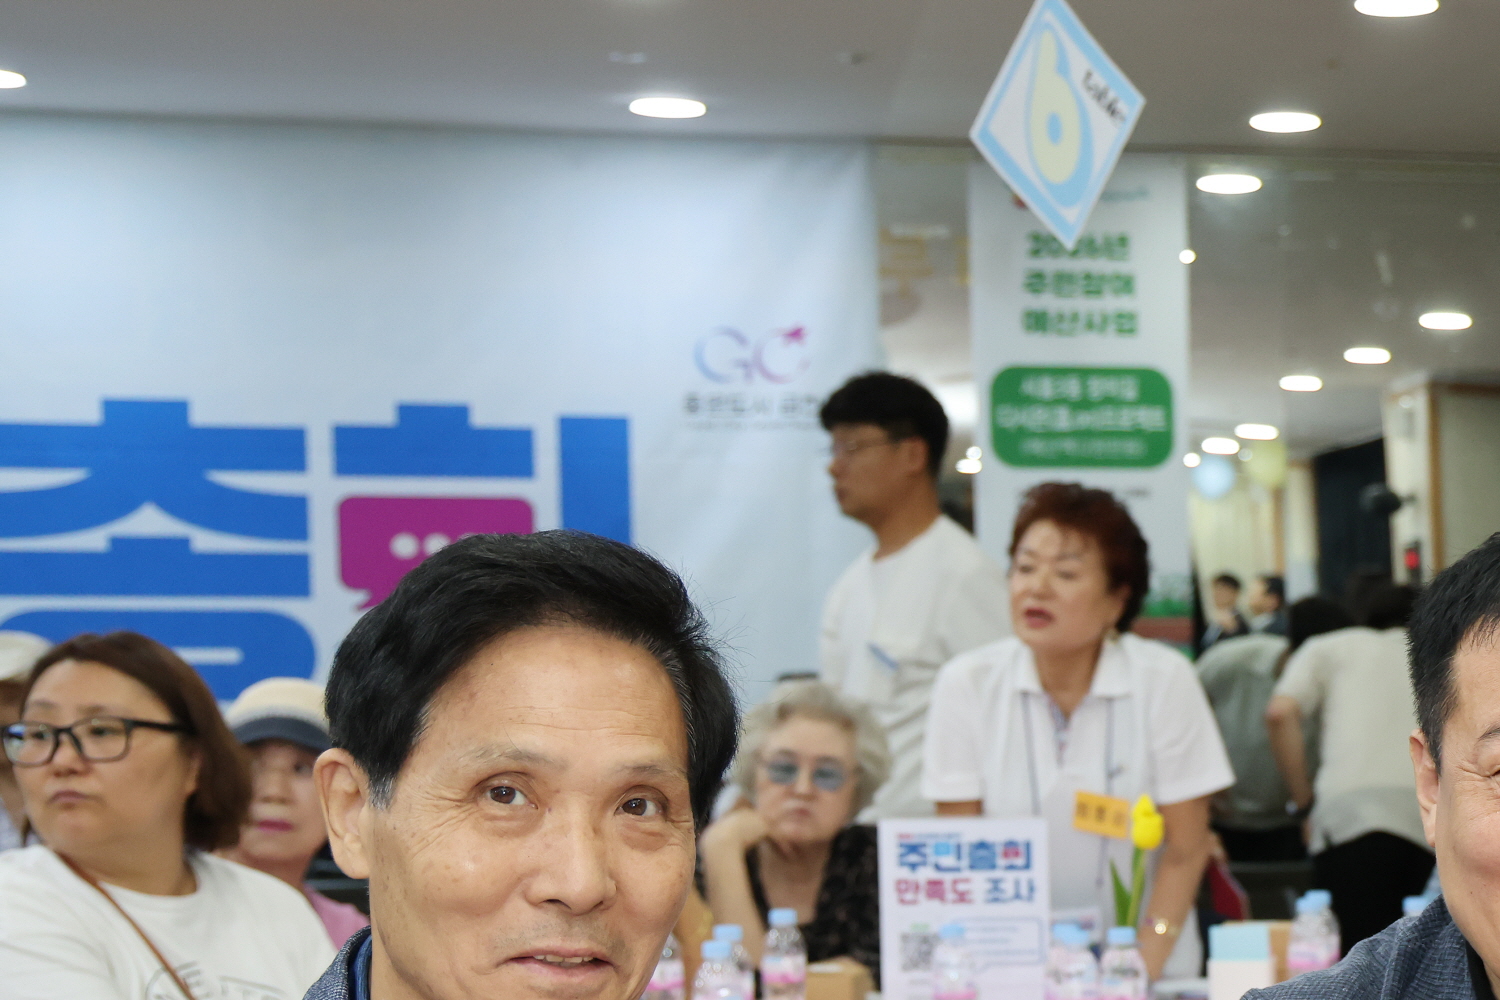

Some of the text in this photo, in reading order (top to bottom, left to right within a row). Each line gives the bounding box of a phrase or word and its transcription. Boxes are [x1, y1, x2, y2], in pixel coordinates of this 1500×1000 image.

[1030, 18, 1091, 205] 6
[897, 839, 1033, 873] 주민총회
[895, 877, 1036, 905] 만족도 조사
